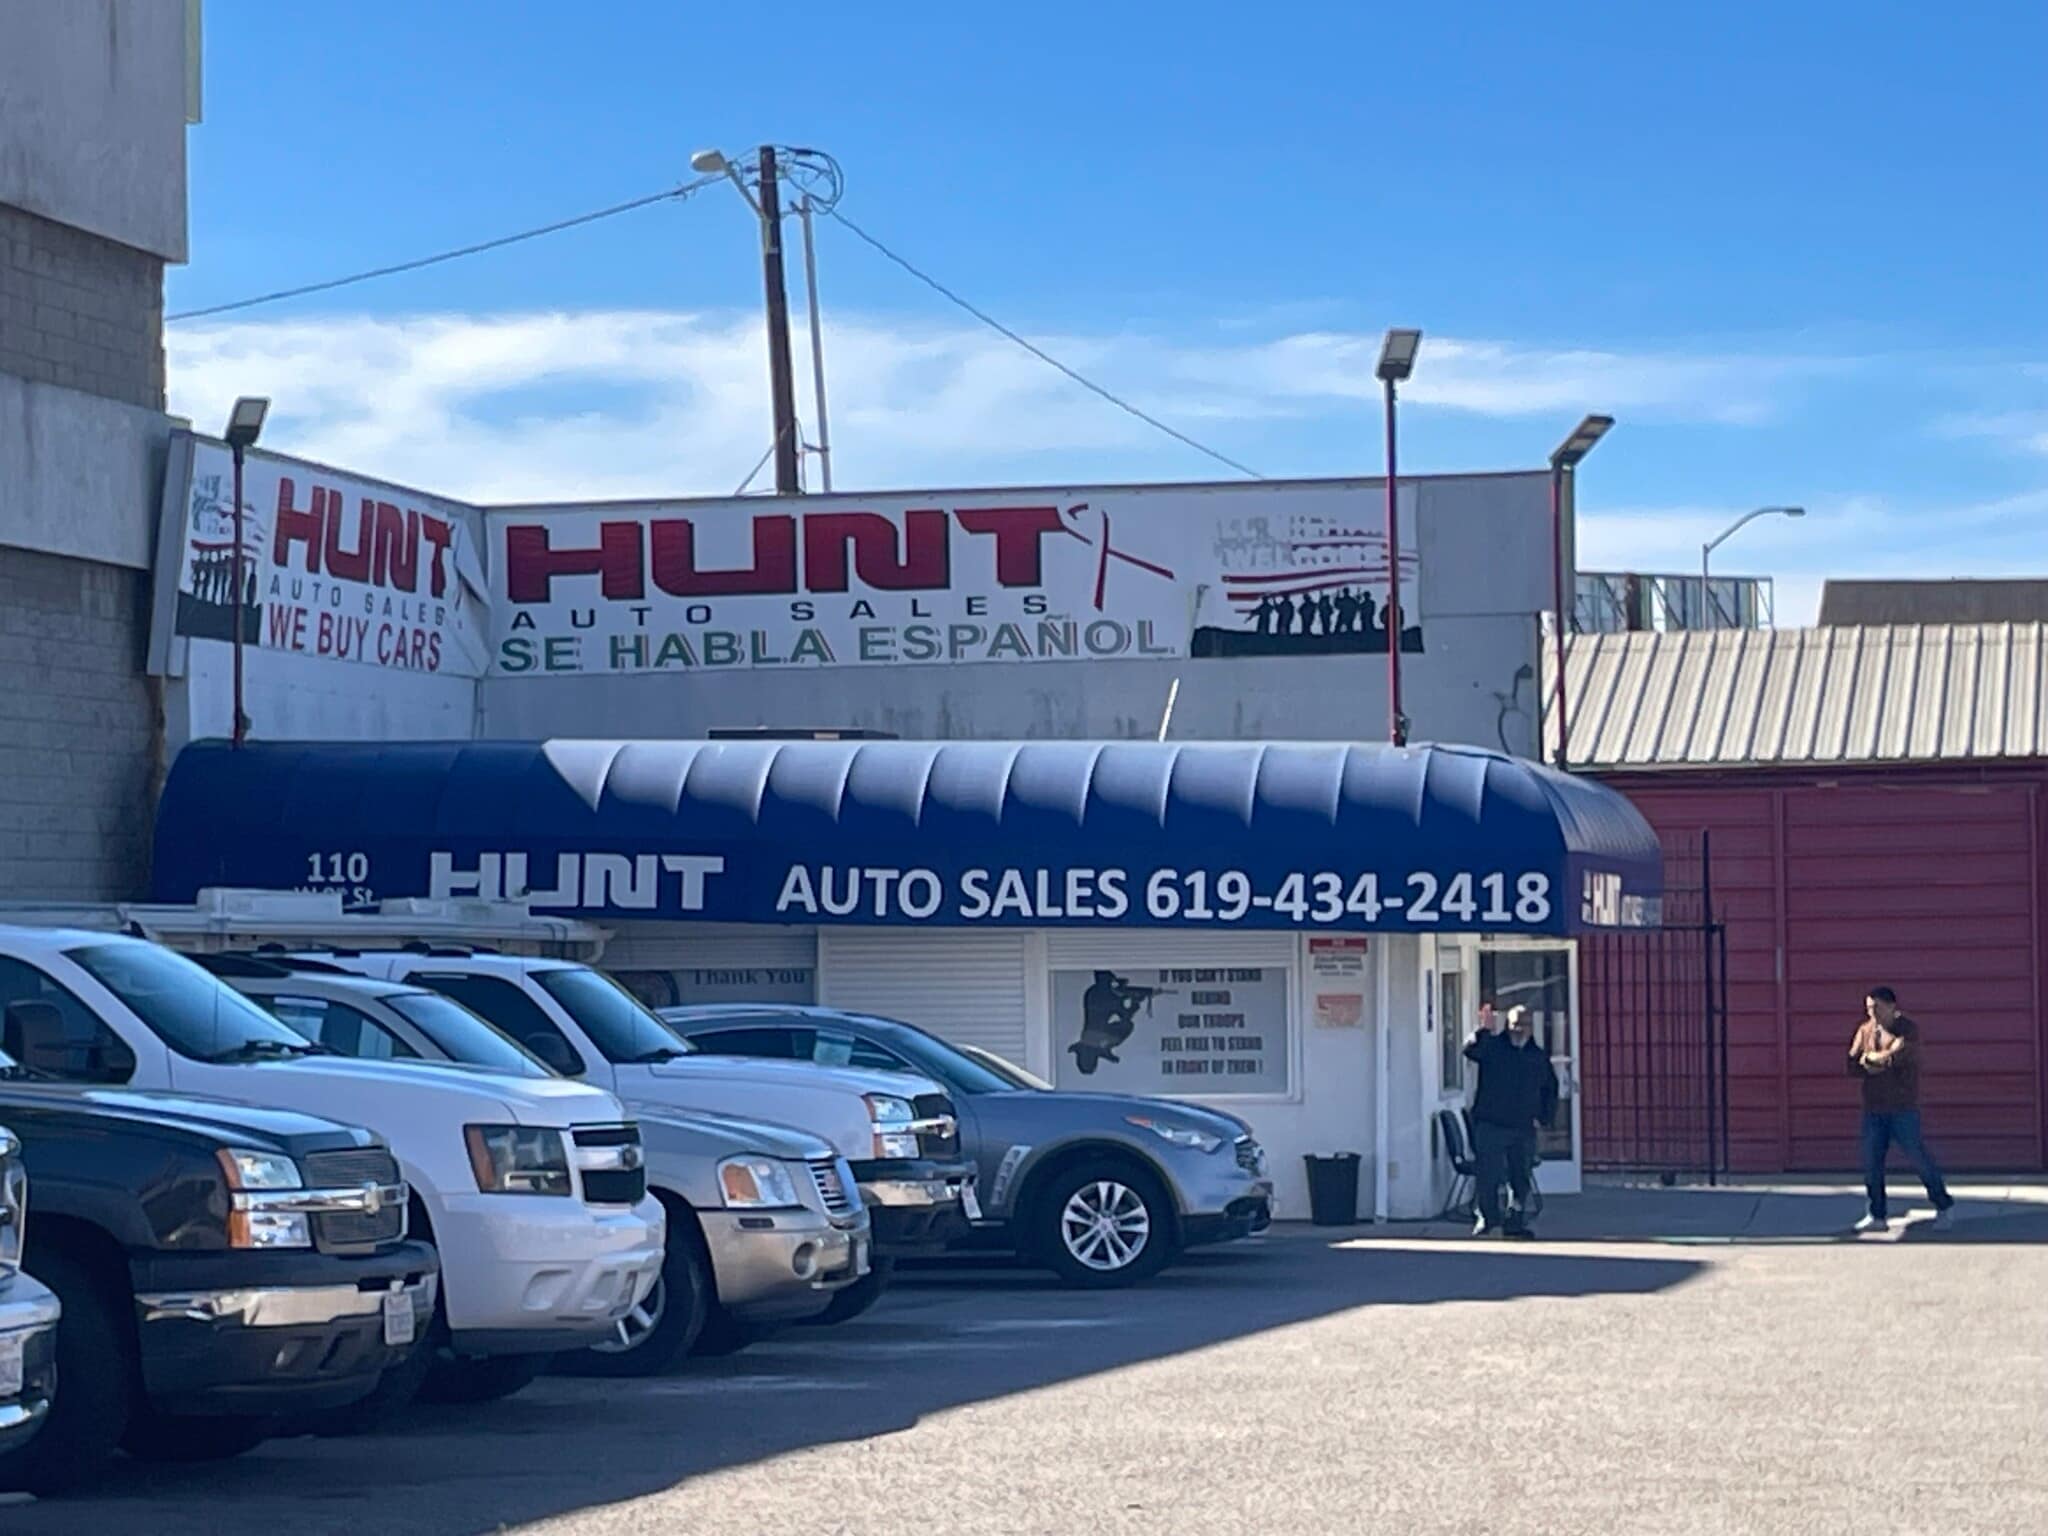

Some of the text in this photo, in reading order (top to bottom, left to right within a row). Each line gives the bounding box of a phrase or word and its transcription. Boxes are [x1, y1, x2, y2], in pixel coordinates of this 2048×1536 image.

[274, 477, 451, 599] HUNT
[506, 508, 1066, 604] HUNT
[270, 573, 446, 627] AUTO SALES
[511, 593, 1048, 631] AUTO SALES
[269, 601, 443, 673] WE BUY CARS
[499, 612, 1176, 672] SE HABLA ESPAÑOL
[307, 851, 369, 883] 110
[430, 851, 725, 911] HUNT
[775, 864, 943, 919] AUTO
[958, 868, 1130, 919] SALES
[1146, 868, 1551, 924] 619-434-2418
[694, 968, 806, 985] Thank You
